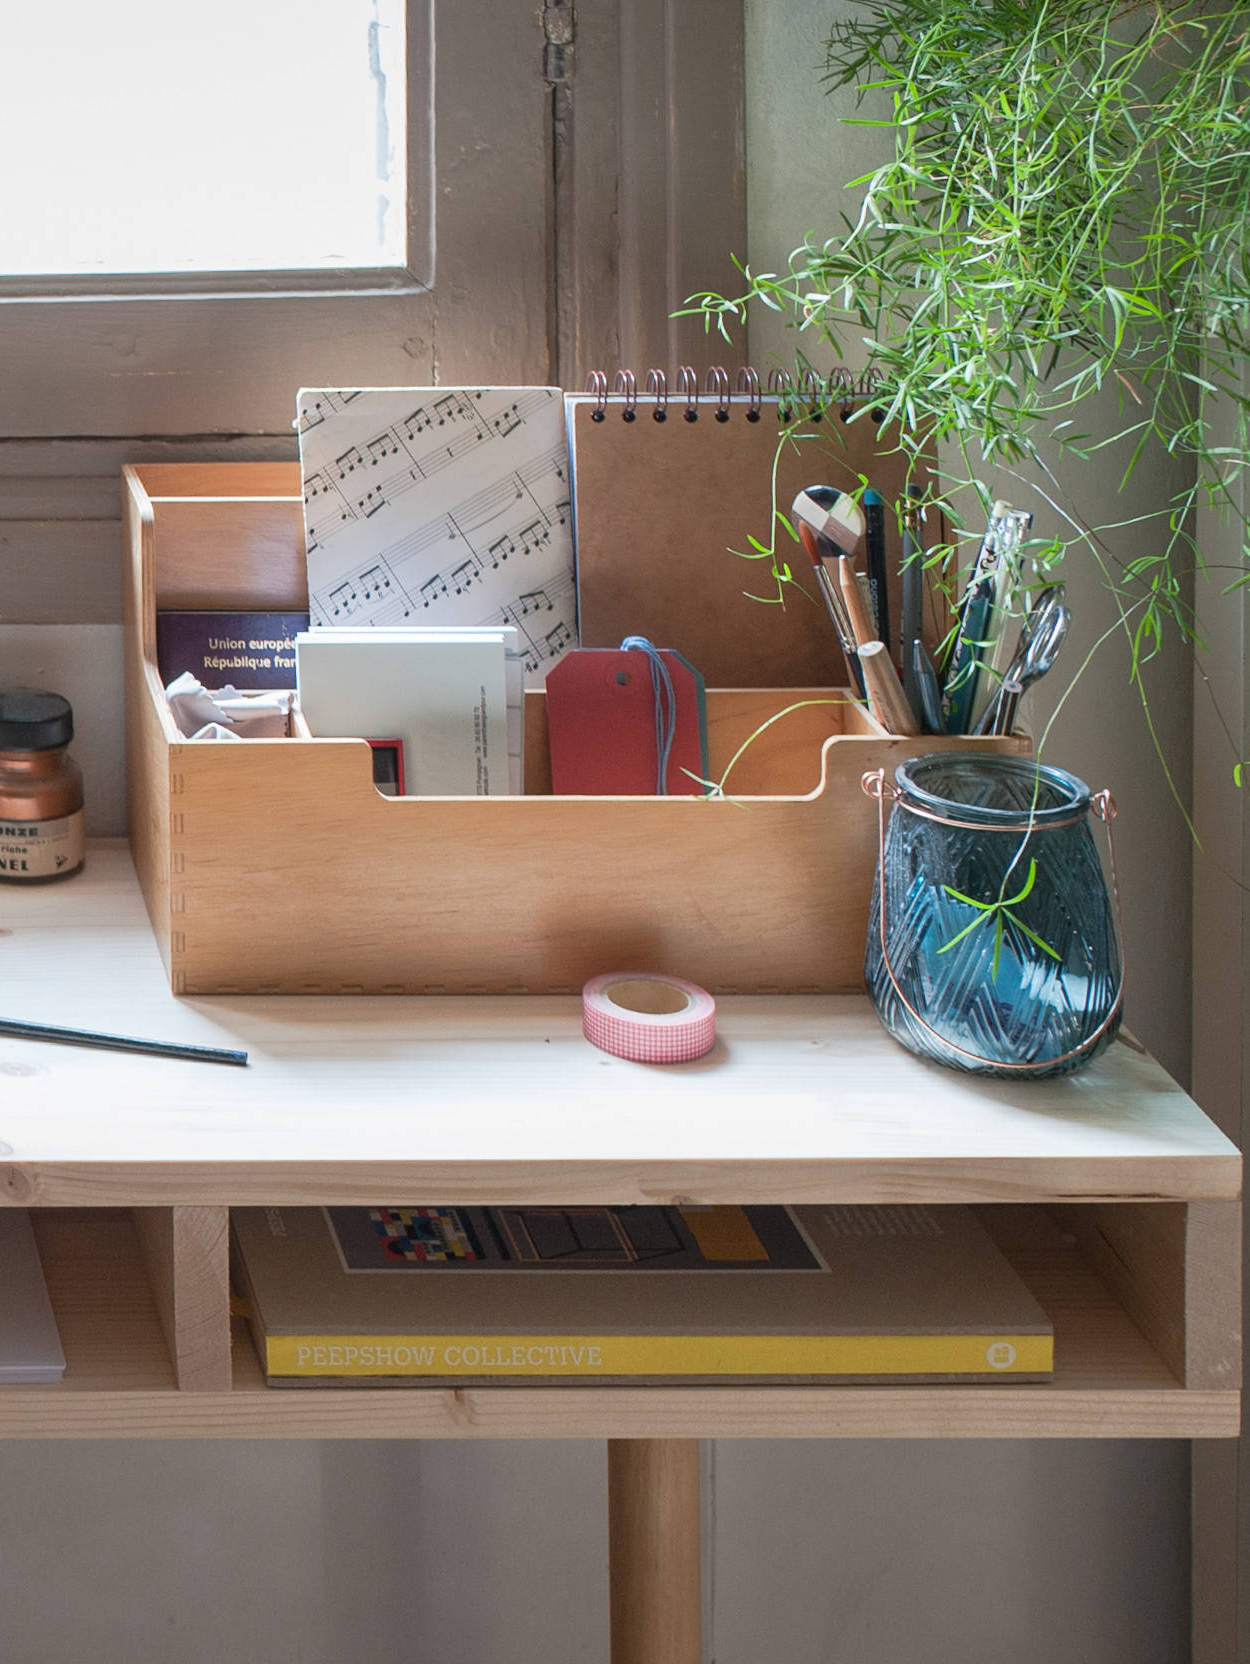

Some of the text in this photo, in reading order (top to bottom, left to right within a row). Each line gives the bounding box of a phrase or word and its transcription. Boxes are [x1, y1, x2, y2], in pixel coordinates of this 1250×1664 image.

[208, 637, 246, 650] Union
[203, 655, 271, 671] République
[1, 845, 28, 854] riche
[296, 1345, 603, 1367] PEEPSHOW COLLECTIVE
